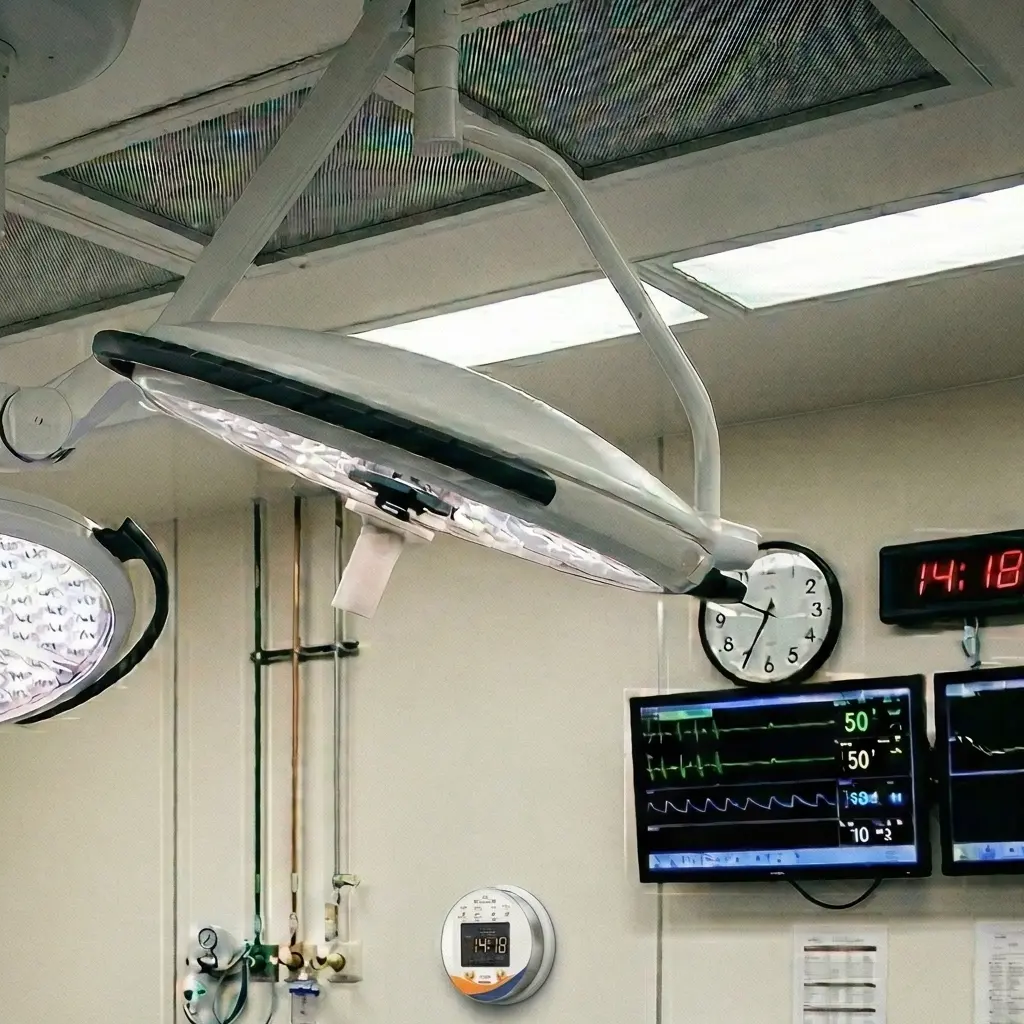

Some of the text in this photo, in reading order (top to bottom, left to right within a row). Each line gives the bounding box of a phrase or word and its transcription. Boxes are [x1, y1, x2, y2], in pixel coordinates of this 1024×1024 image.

[918, 549, 1023, 596] 14:18
[805, 578, 816, 594] 2
[811, 602, 823, 617] 3
[715, 613, 726, 629] 9
[804, 627, 816, 643] 4
[723, 636, 734, 652] 8
[787, 646, 799, 664] 5
[764, 655, 775, 673] 6
[844, 710, 869, 733] 50
[474, 936, 507, 954] 14:18
